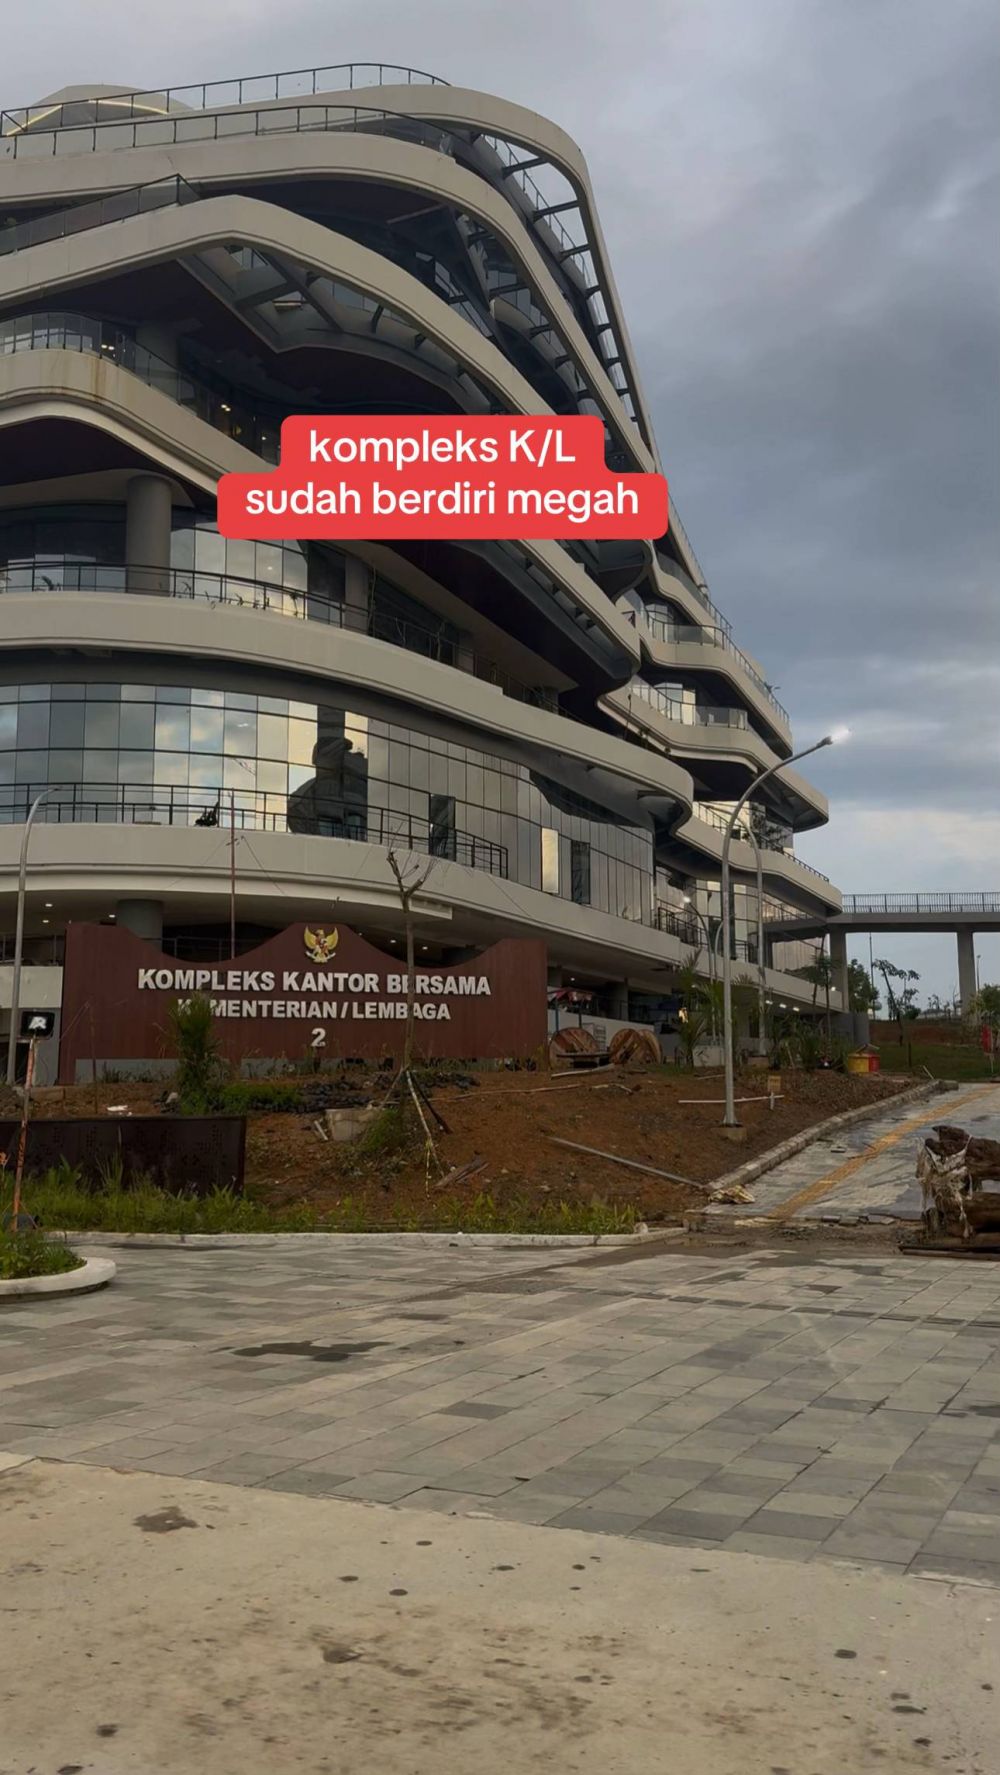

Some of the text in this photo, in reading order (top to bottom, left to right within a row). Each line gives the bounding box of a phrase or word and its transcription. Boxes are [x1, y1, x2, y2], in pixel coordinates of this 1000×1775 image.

[138, 968, 275, 991] KOMPLEKS
[282, 971, 380, 993] KANTOR
[311, 1027, 326, 1047] 2
